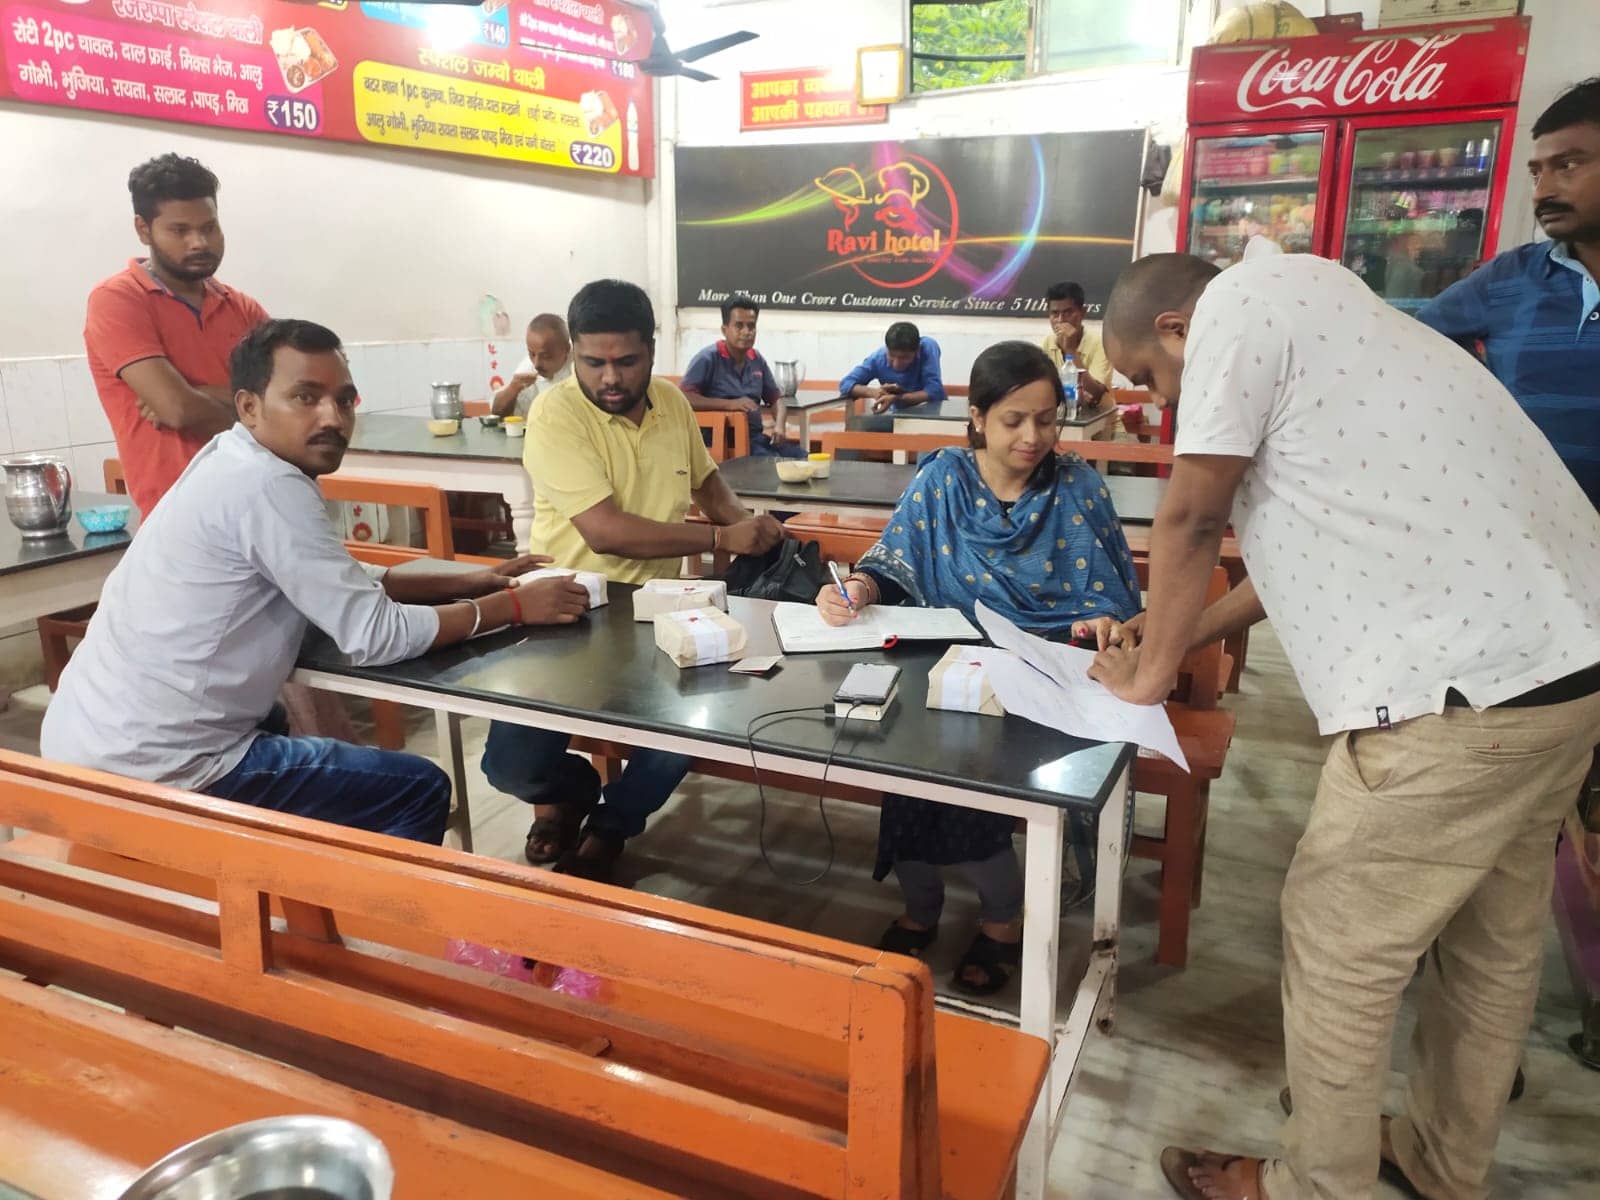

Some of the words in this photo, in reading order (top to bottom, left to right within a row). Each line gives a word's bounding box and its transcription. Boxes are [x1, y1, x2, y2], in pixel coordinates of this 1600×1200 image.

[12, 16, 39, 45] रोटी
[41, 20, 75, 55] 2pc
[121, 42, 146, 63] दाल
[513, 66, 546, 90] थाली
[1237, 36, 1450, 113] Coca-Cola
[751, 79, 799, 99] आपका
[267, 100, 317, 130] ₹150
[751, 99, 800, 122] आपकी
[572, 144, 613, 168] ₹220
[827, 229, 877, 255] Ravi
[884, 229, 940, 256] hotel
[698, 289, 730, 301] More
[771, 291, 797, 304] One
[801, 292, 838, 305] Crore
[842, 293, 907, 307] Customer
[909, 295, 960, 310] Service
[964, 297, 1006, 311] Since
